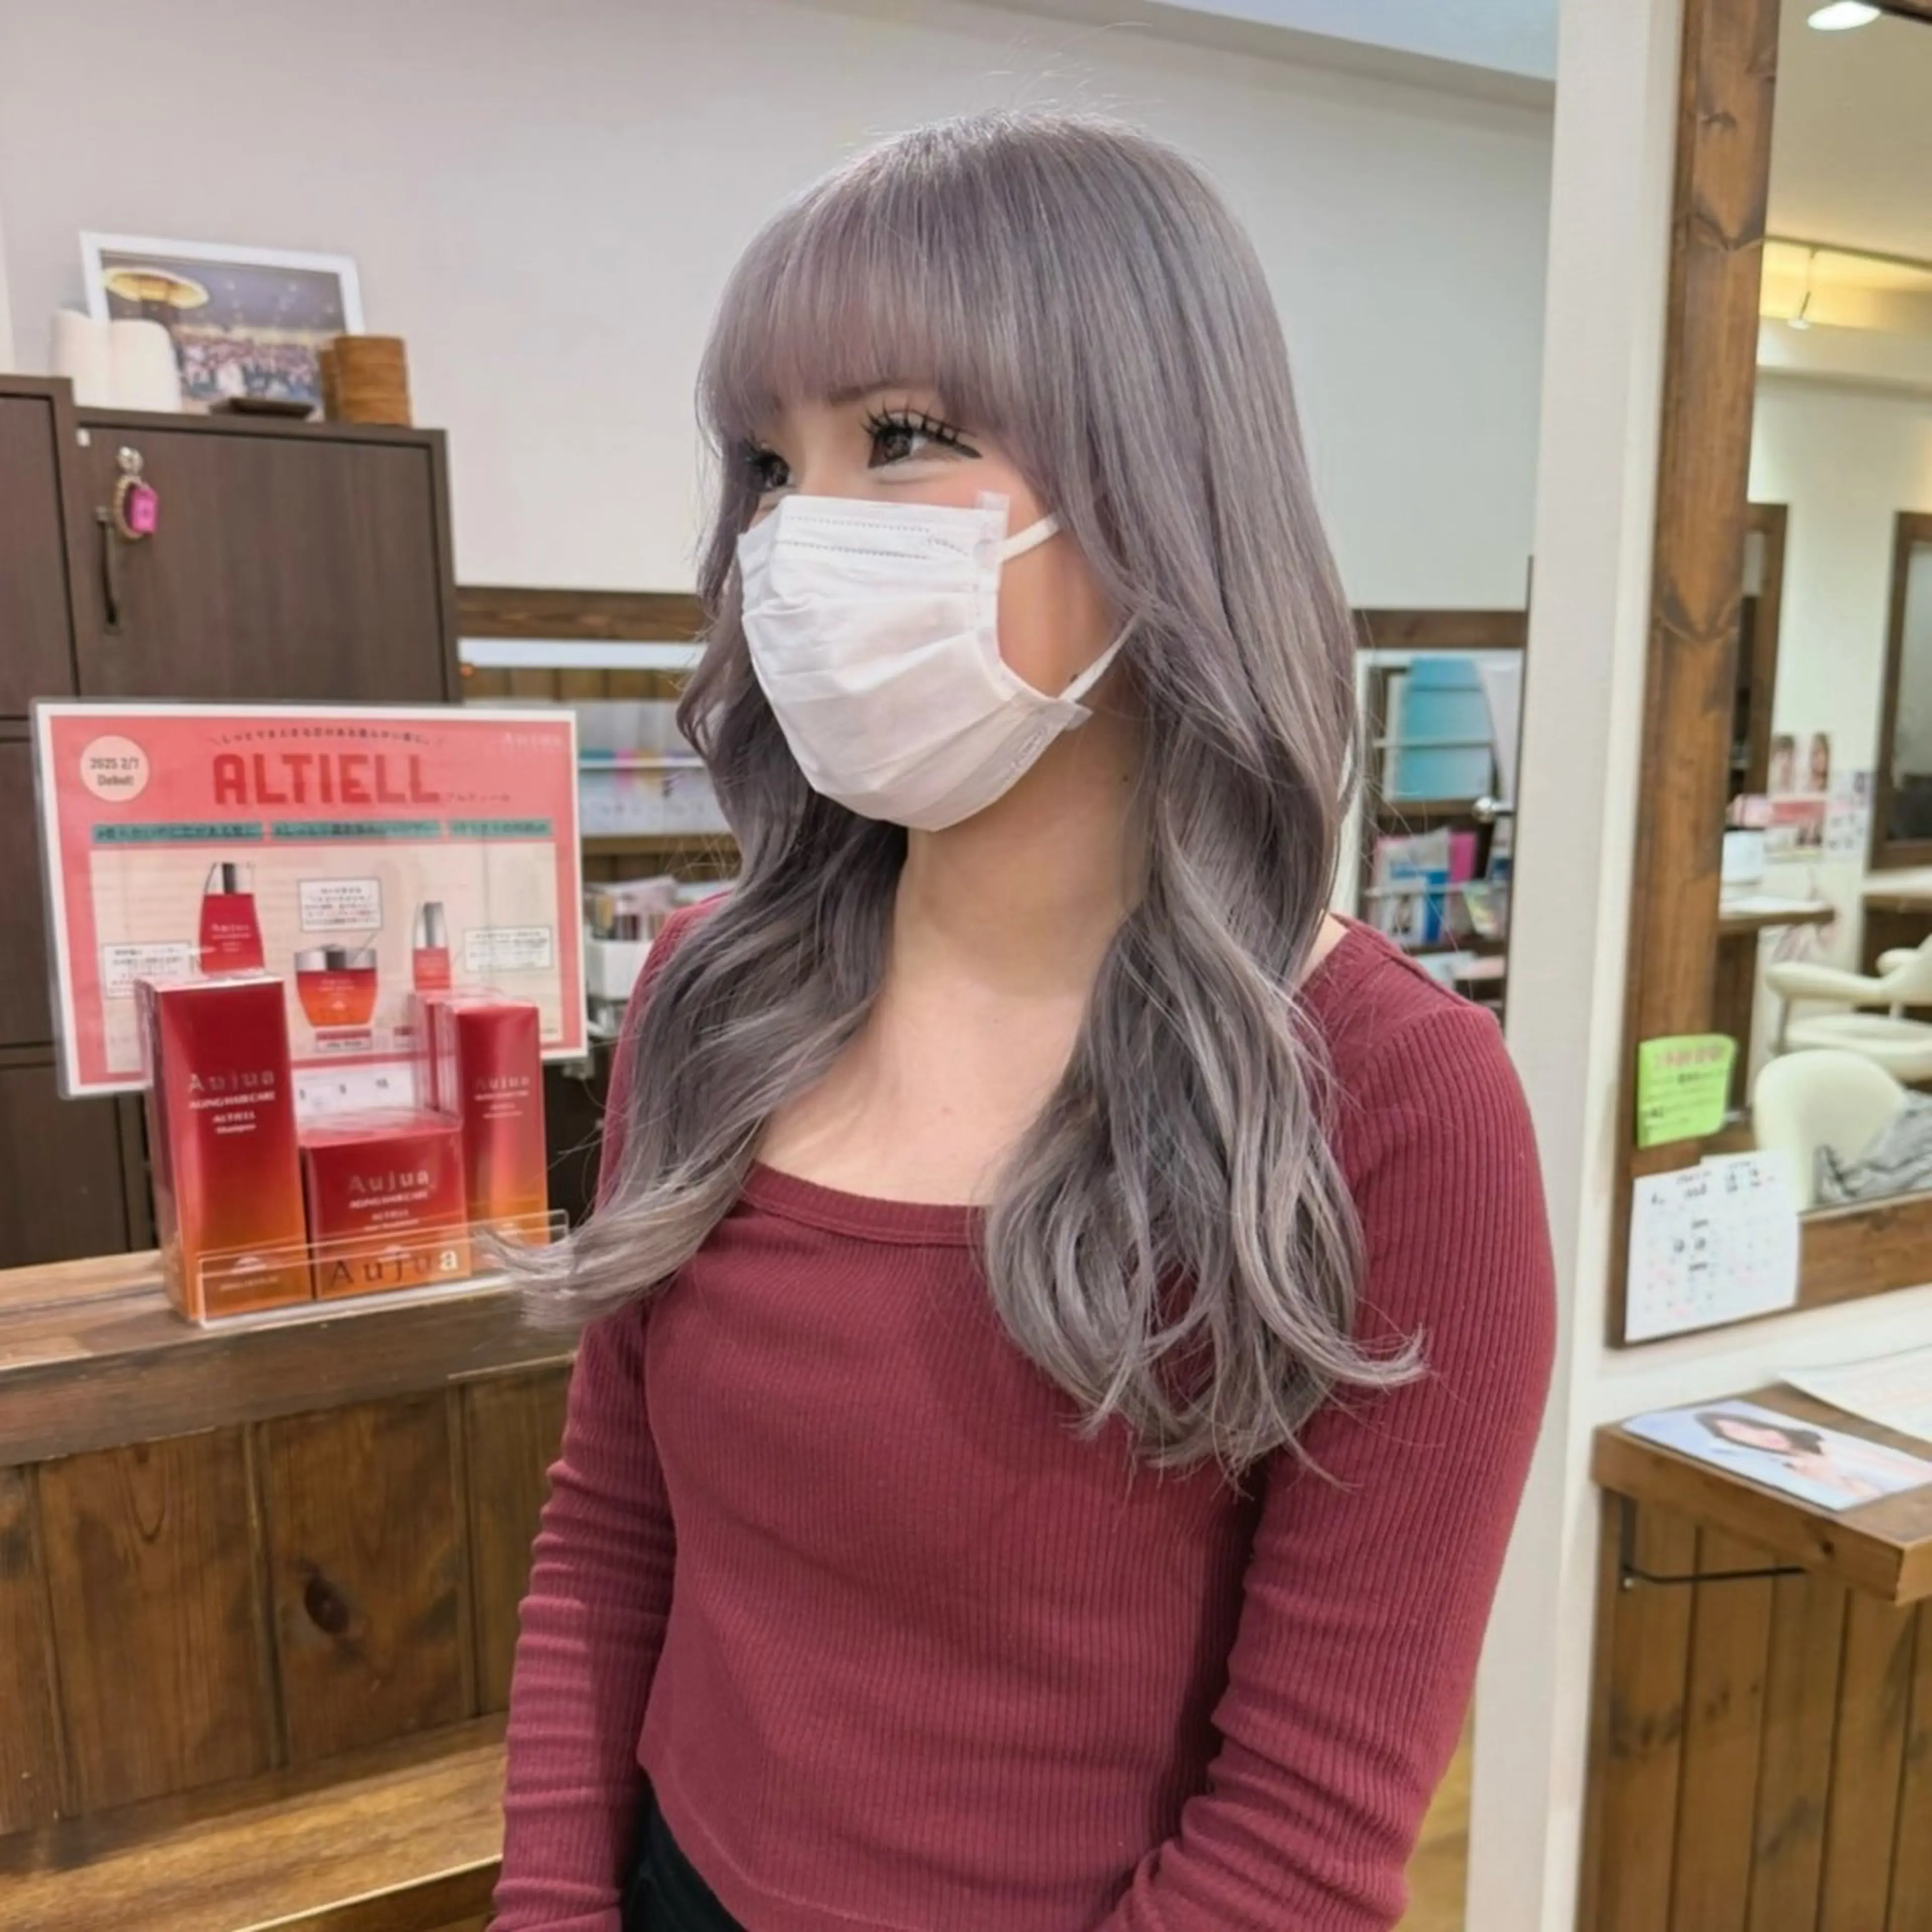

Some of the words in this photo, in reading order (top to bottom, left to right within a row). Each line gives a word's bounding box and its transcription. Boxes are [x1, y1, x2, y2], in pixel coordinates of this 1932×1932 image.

[90, 757, 118, 770] 2025
[213, 753, 440, 804] ALTIELL
[348, 1170, 429, 1194] Aujua
[329, 1250, 458, 1286] Aujua
